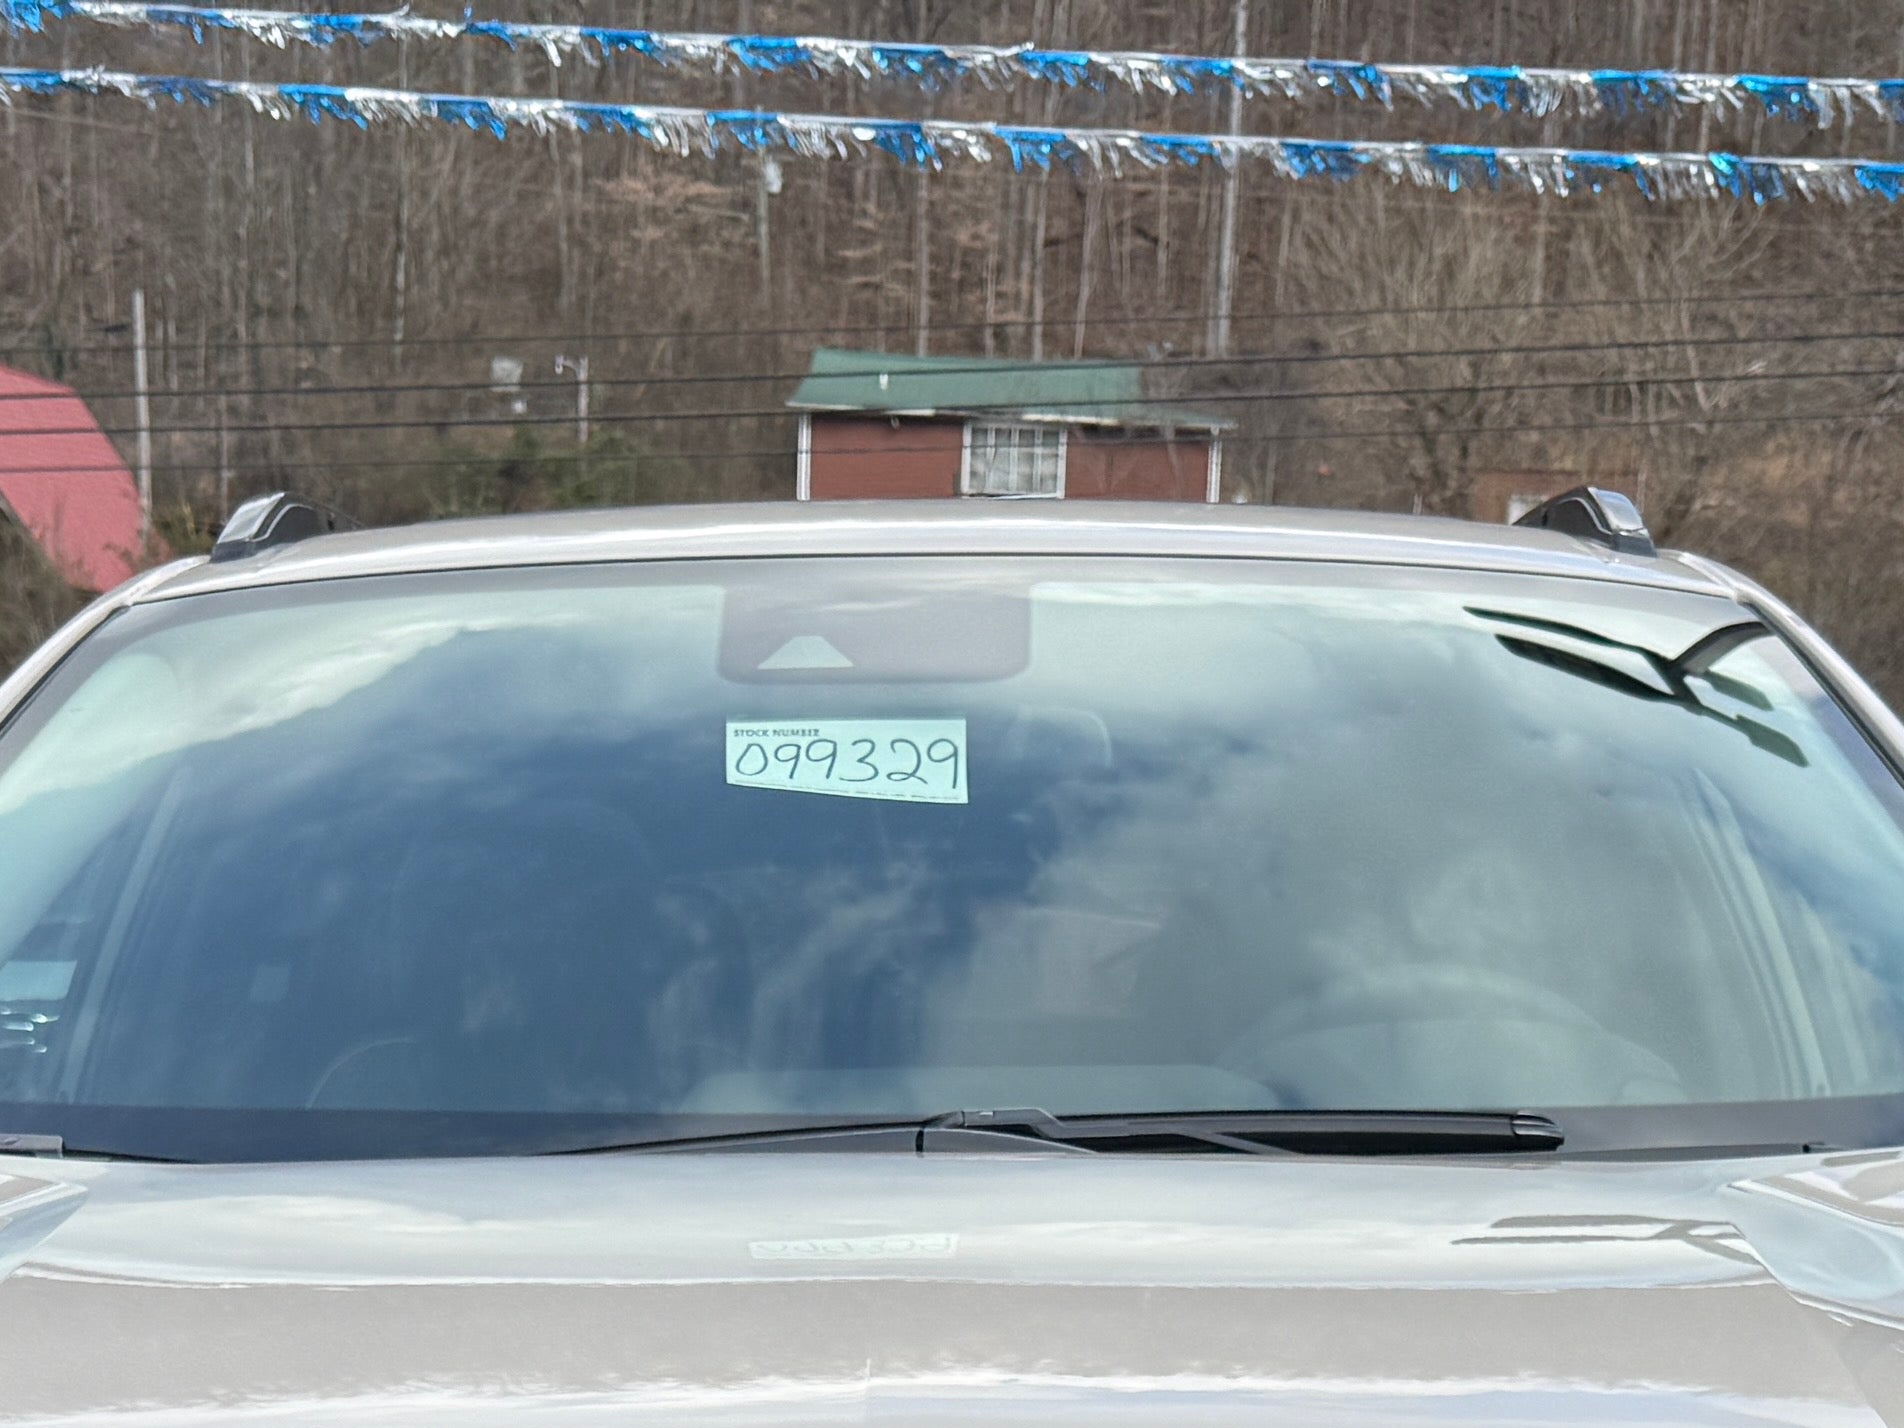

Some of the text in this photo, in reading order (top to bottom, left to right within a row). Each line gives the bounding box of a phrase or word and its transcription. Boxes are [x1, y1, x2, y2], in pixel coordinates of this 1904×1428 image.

[734, 728, 820, 738] STOCK NUMBER
[735, 738, 958, 789] 099329
